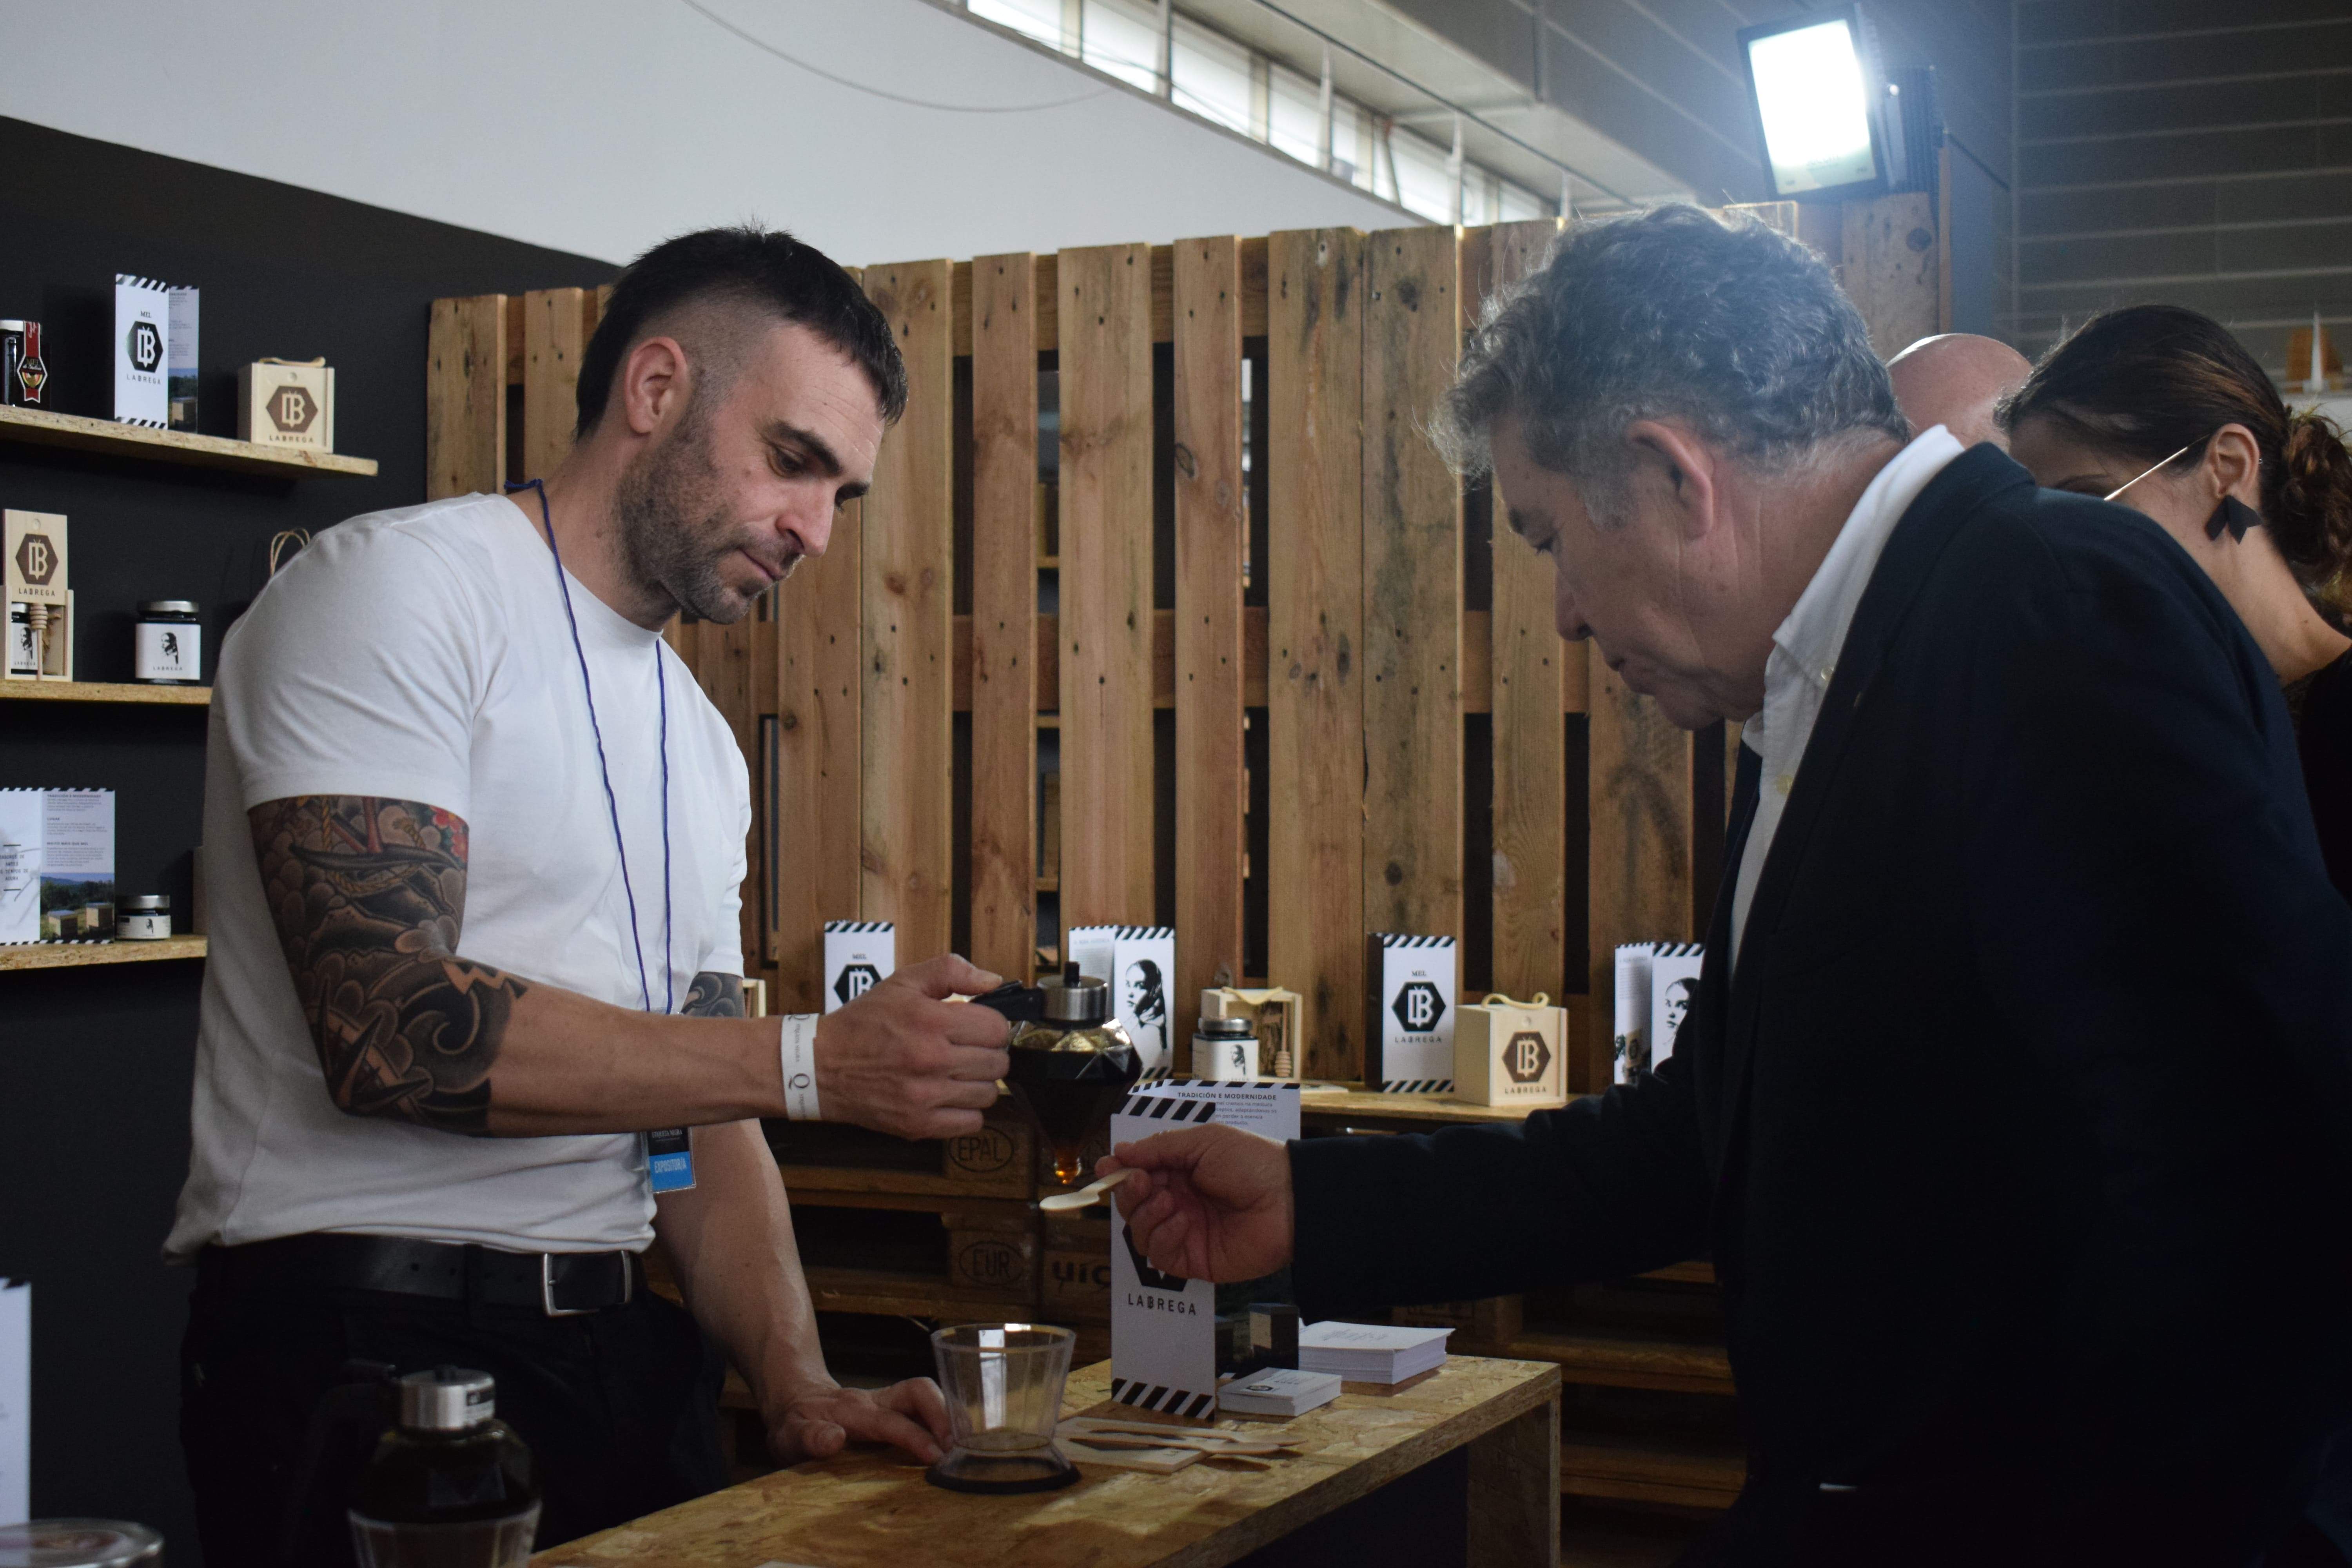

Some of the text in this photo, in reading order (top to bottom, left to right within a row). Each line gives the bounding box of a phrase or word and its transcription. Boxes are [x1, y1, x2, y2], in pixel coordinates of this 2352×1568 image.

[127, 374, 161, 385] LABREGA
[269, 435, 314, 443] LABREGA
[18, 588, 55, 597] LABREGA
[957, 1137, 1004, 1163] EPAL
[973, 1248, 1011, 1278] EUR
[1128, 1293, 1196, 1316] LABREGA
